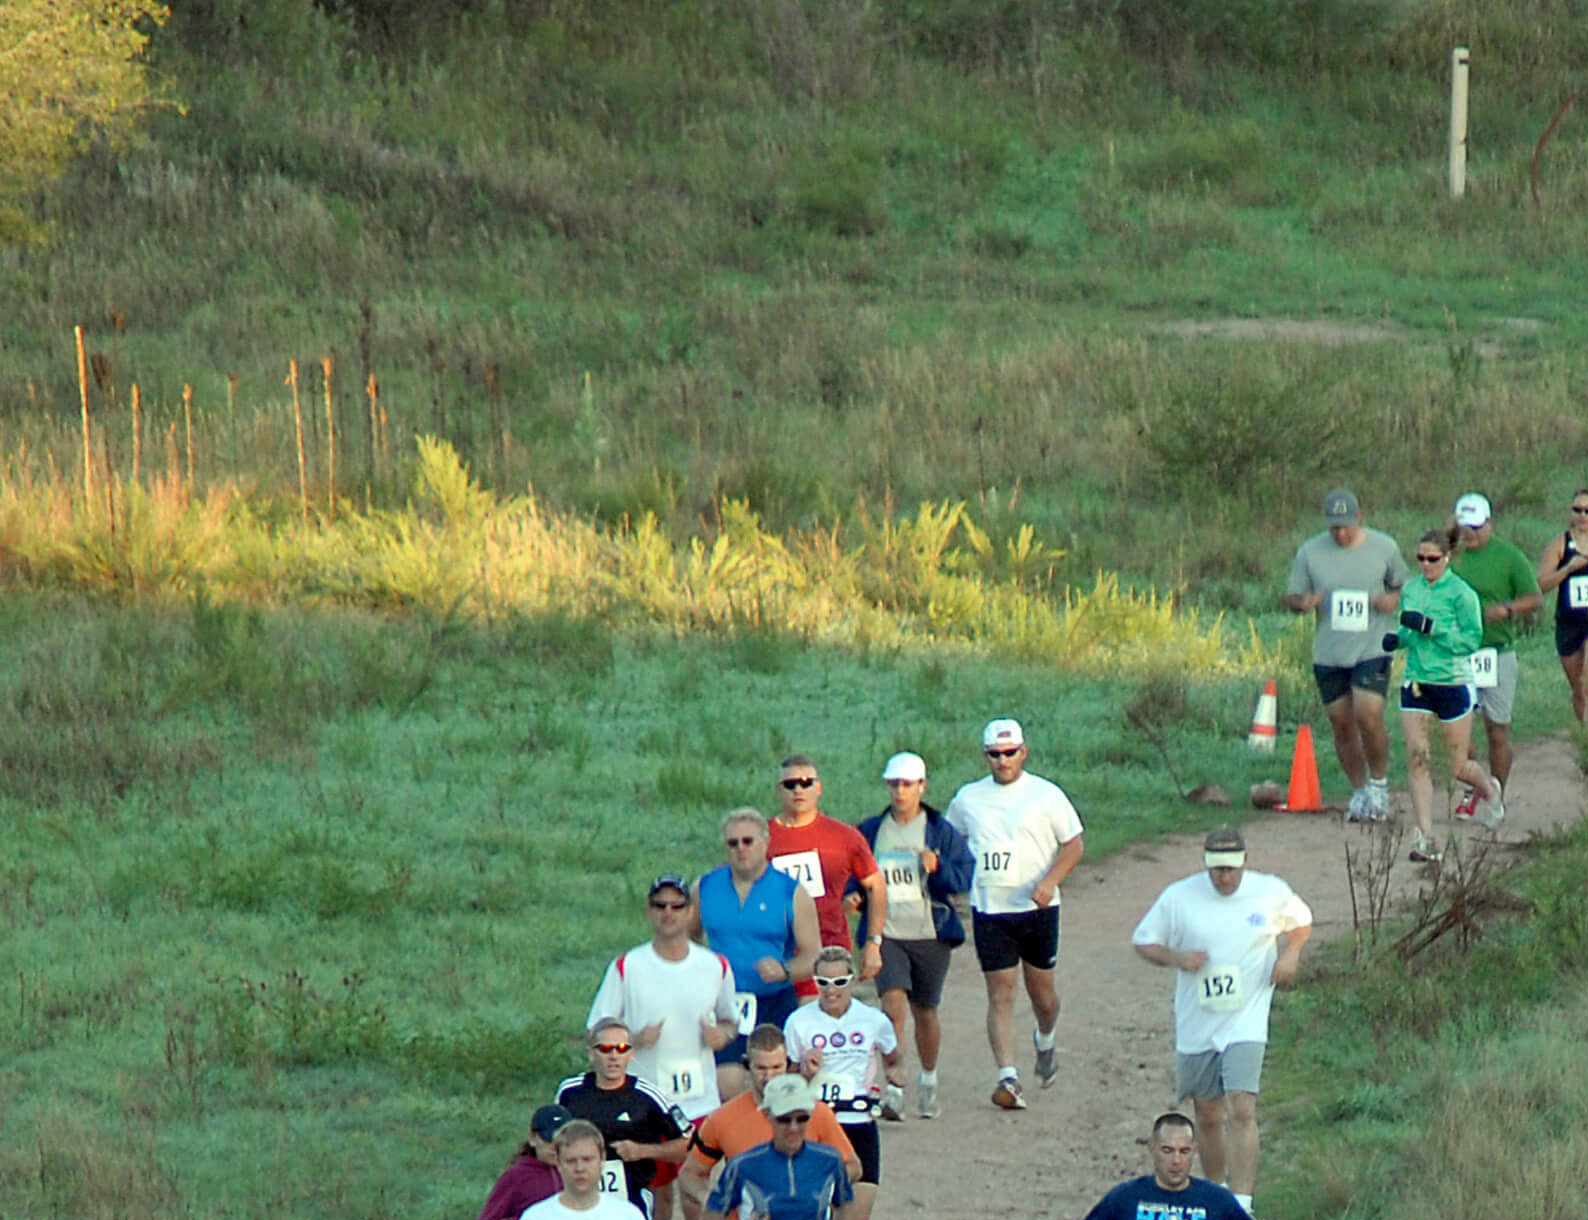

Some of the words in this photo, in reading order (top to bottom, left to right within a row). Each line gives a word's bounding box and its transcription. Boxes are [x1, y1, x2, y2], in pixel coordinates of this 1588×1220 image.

[1338, 600, 1363, 617] 159
[983, 852, 1012, 870] 107
[1204, 976, 1234, 998] 152
[672, 1072, 692, 1093] 19
[821, 1083, 841, 1102] 18
